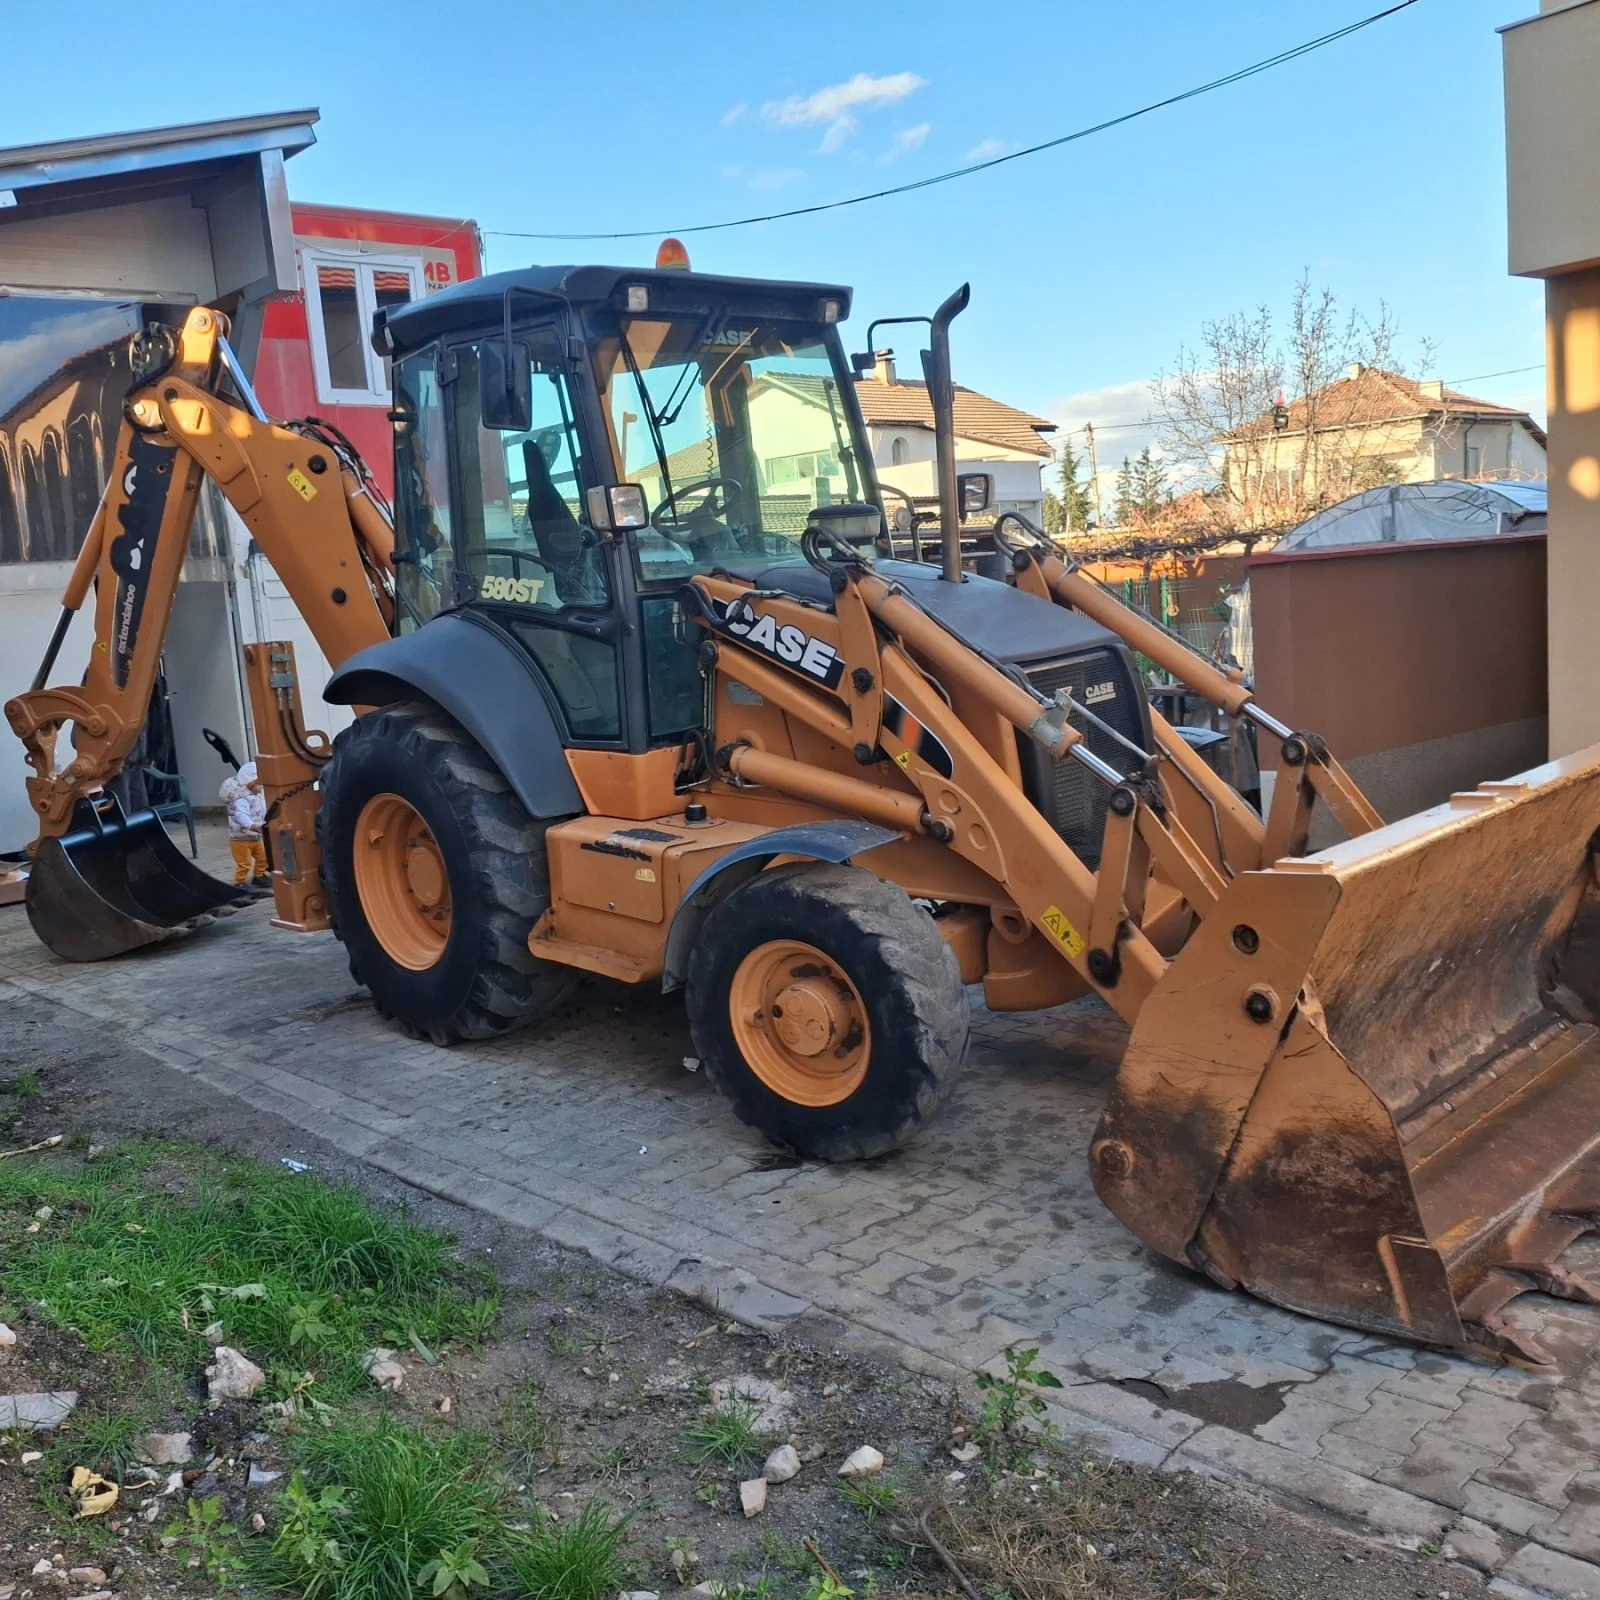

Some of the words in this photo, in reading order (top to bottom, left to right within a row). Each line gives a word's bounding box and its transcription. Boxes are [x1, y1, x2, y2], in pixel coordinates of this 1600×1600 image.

[702, 330, 752, 346] CASE
[481, 575, 544, 604] 580ST
[118, 584, 136, 654] extendahoe
[725, 599, 837, 679] CASE
[1085, 681, 1115, 699] CASE
